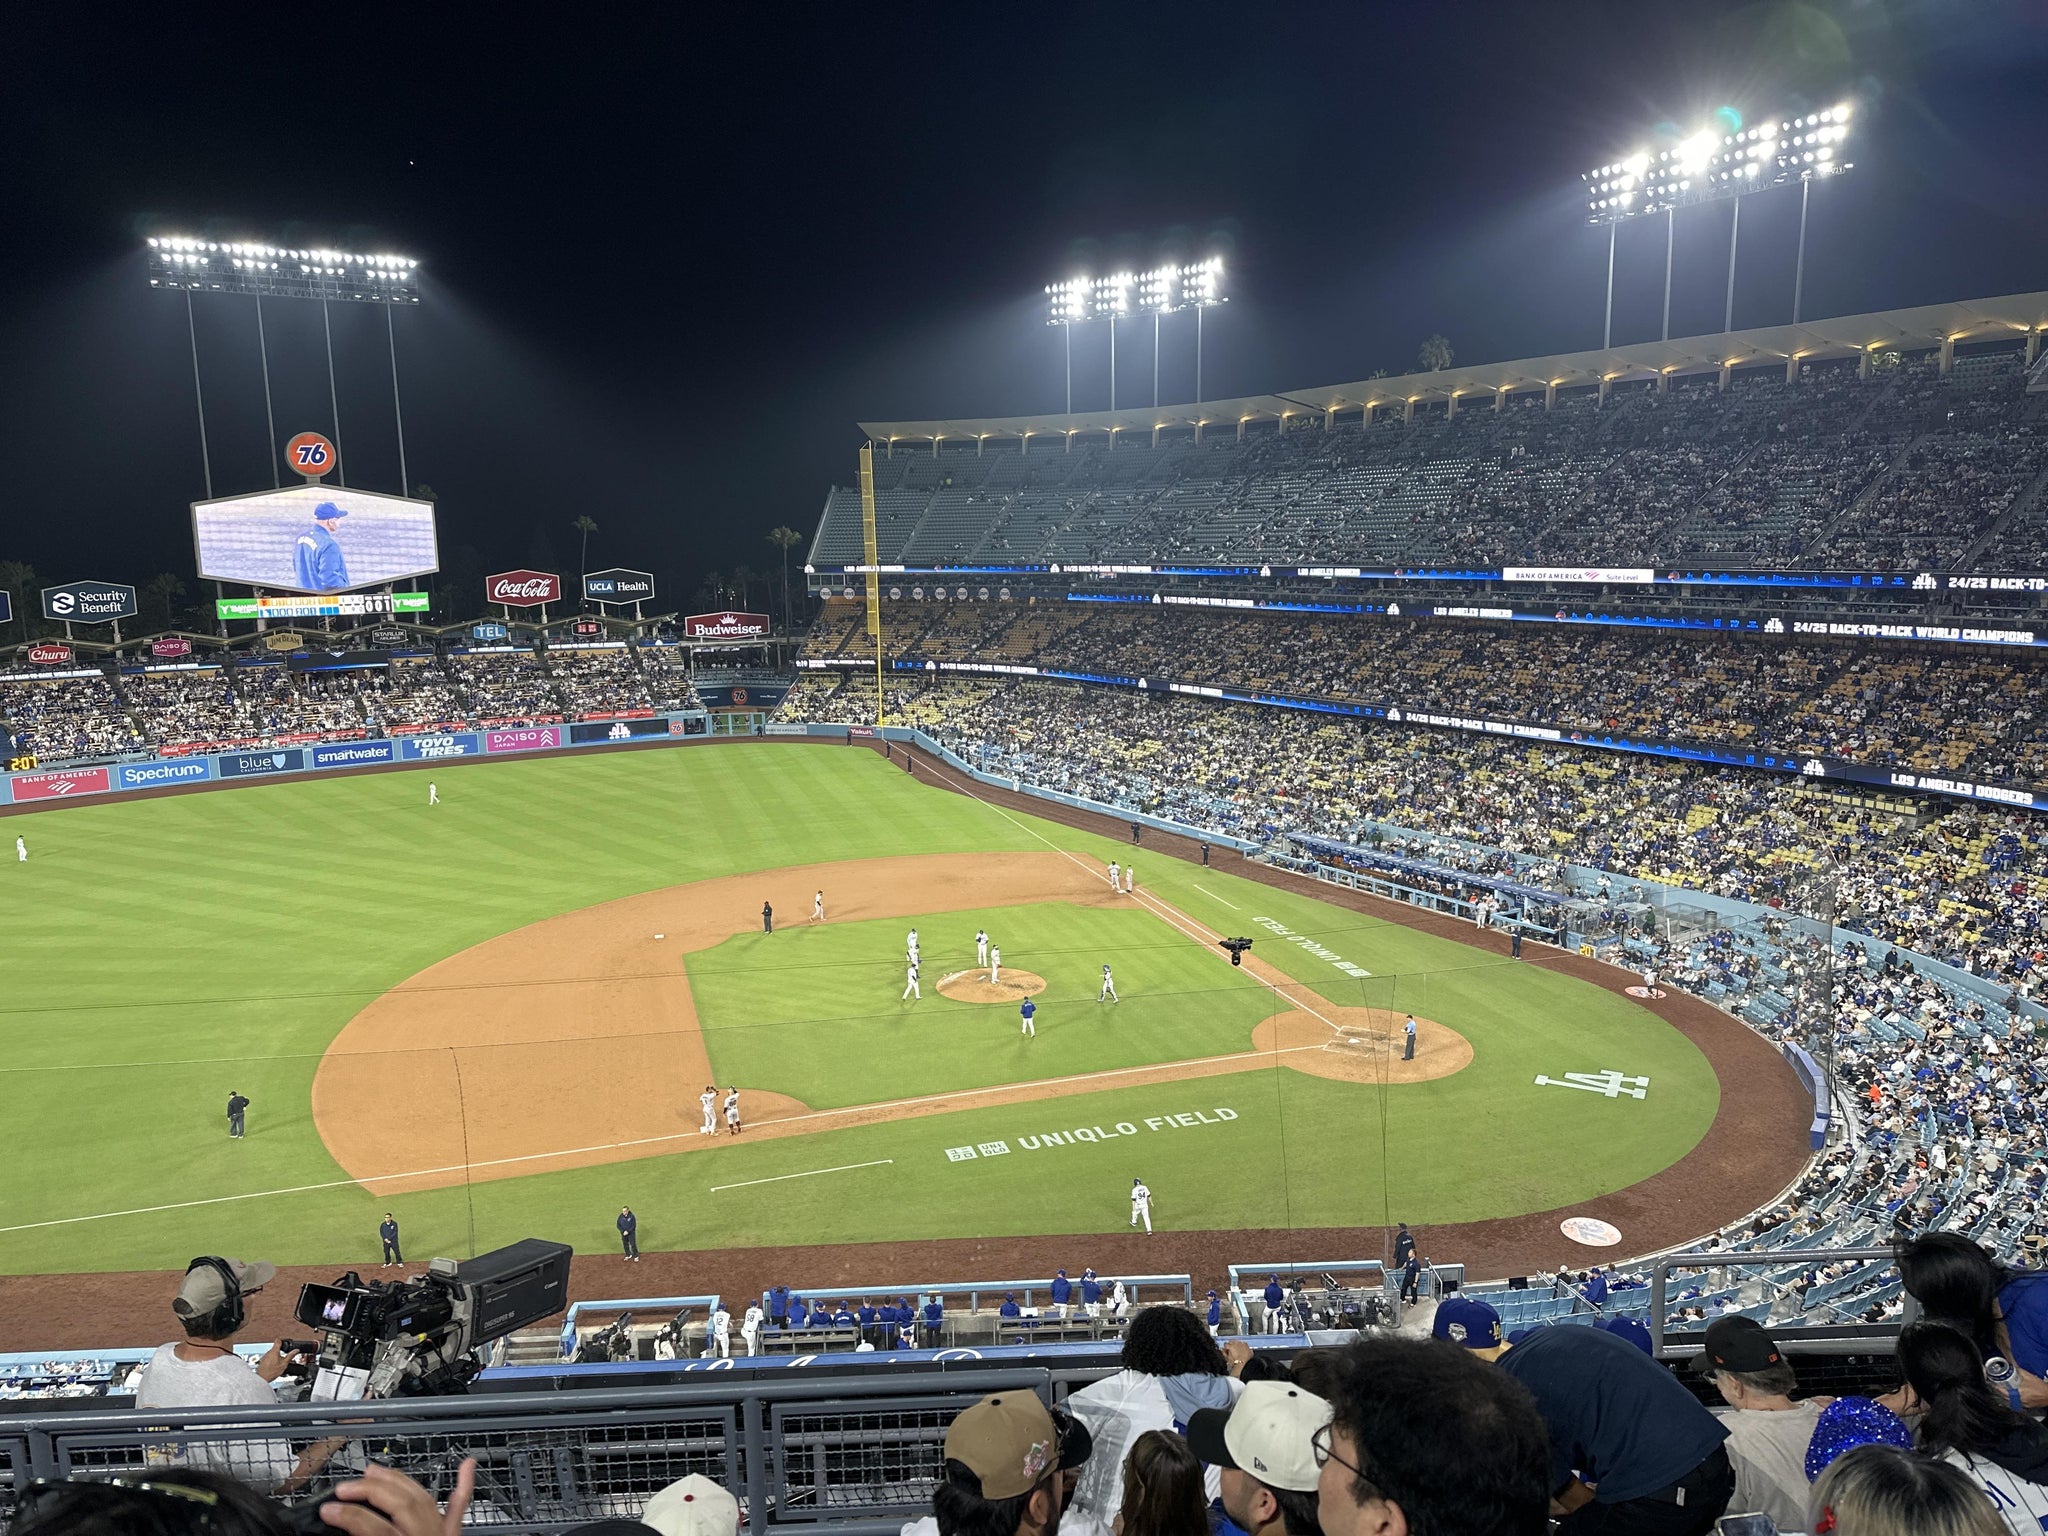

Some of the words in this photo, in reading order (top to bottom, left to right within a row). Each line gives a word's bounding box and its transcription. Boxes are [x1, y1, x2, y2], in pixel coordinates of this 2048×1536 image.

[296, 443, 327, 465] 76
[494, 578, 552, 598] Coca-Cola
[589, 583, 613, 591] UCLA
[617, 582, 648, 591] Health
[1949, 577, 1988, 589] 24/25
[79, 591, 127, 603] Security
[81, 602, 122, 614] Benefit
[477, 627, 503, 637] TEL
[694, 624, 762, 636] Budweiser
[1793, 621, 1828, 633] 24/25
[1830, 623, 1912, 637] BACK-TO-BACK
[1916, 626, 1959, 639] WORLD
[1962, 629, 2034, 643] CHAMPIONS
[30, 650, 68, 661] Churu
[734, 691, 745, 700] 76
[1406, 712, 1428, 723] 24/25
[1430, 713, 1484, 730] BACK-TO-BACK
[671, 724, 682, 732] 76
[850, 728, 873, 736] Yakult
[413, 737, 454, 749] TOYO
[494, 732, 537, 743] DAISO
[318, 747, 389, 763] smartwater
[420, 745, 465, 757] TIRES
[11, 756, 38, 771] 2:07
[239, 756, 271, 769] blue
[22, 776, 46, 784] BANK
[61, 770, 98, 779] AMERICA
[125, 764, 199, 783] Spectrum
[1891, 773, 1917, 787] LOS
[1918, 777, 1973, 795] ANGELES
[1976, 785, 2033, 806] DODGERS
[1252, 916, 1296, 935] FIELD
[1286, 935, 1342, 961] UNIQLO
[1017, 1121, 1138, 1150] UNIQLO
[1143, 1107, 1239, 1131] FIELD
